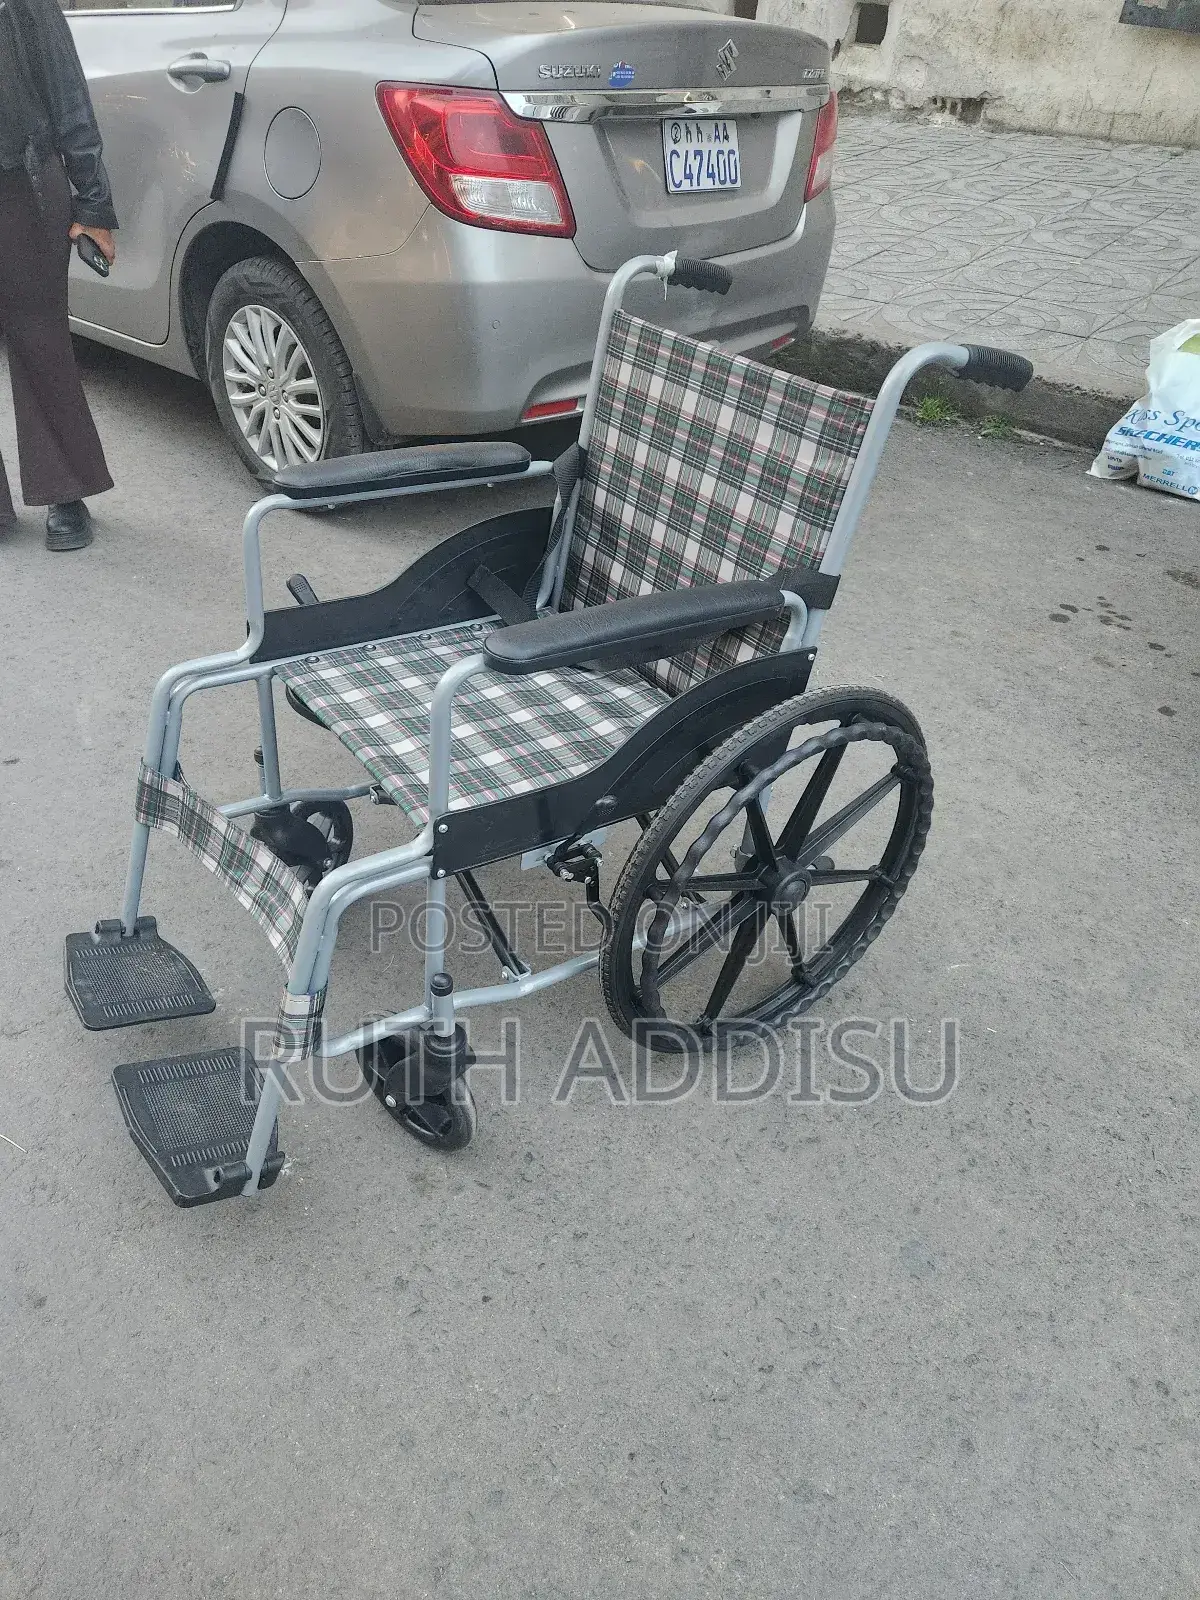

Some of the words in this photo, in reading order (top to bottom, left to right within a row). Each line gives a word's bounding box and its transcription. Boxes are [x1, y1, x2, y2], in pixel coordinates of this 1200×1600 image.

[538, 64, 600, 79] SUZUKI
[714, 122, 730, 143] AA
[669, 149, 738, 188] C47400
[1142, 473, 1188, 492] MERRELL
